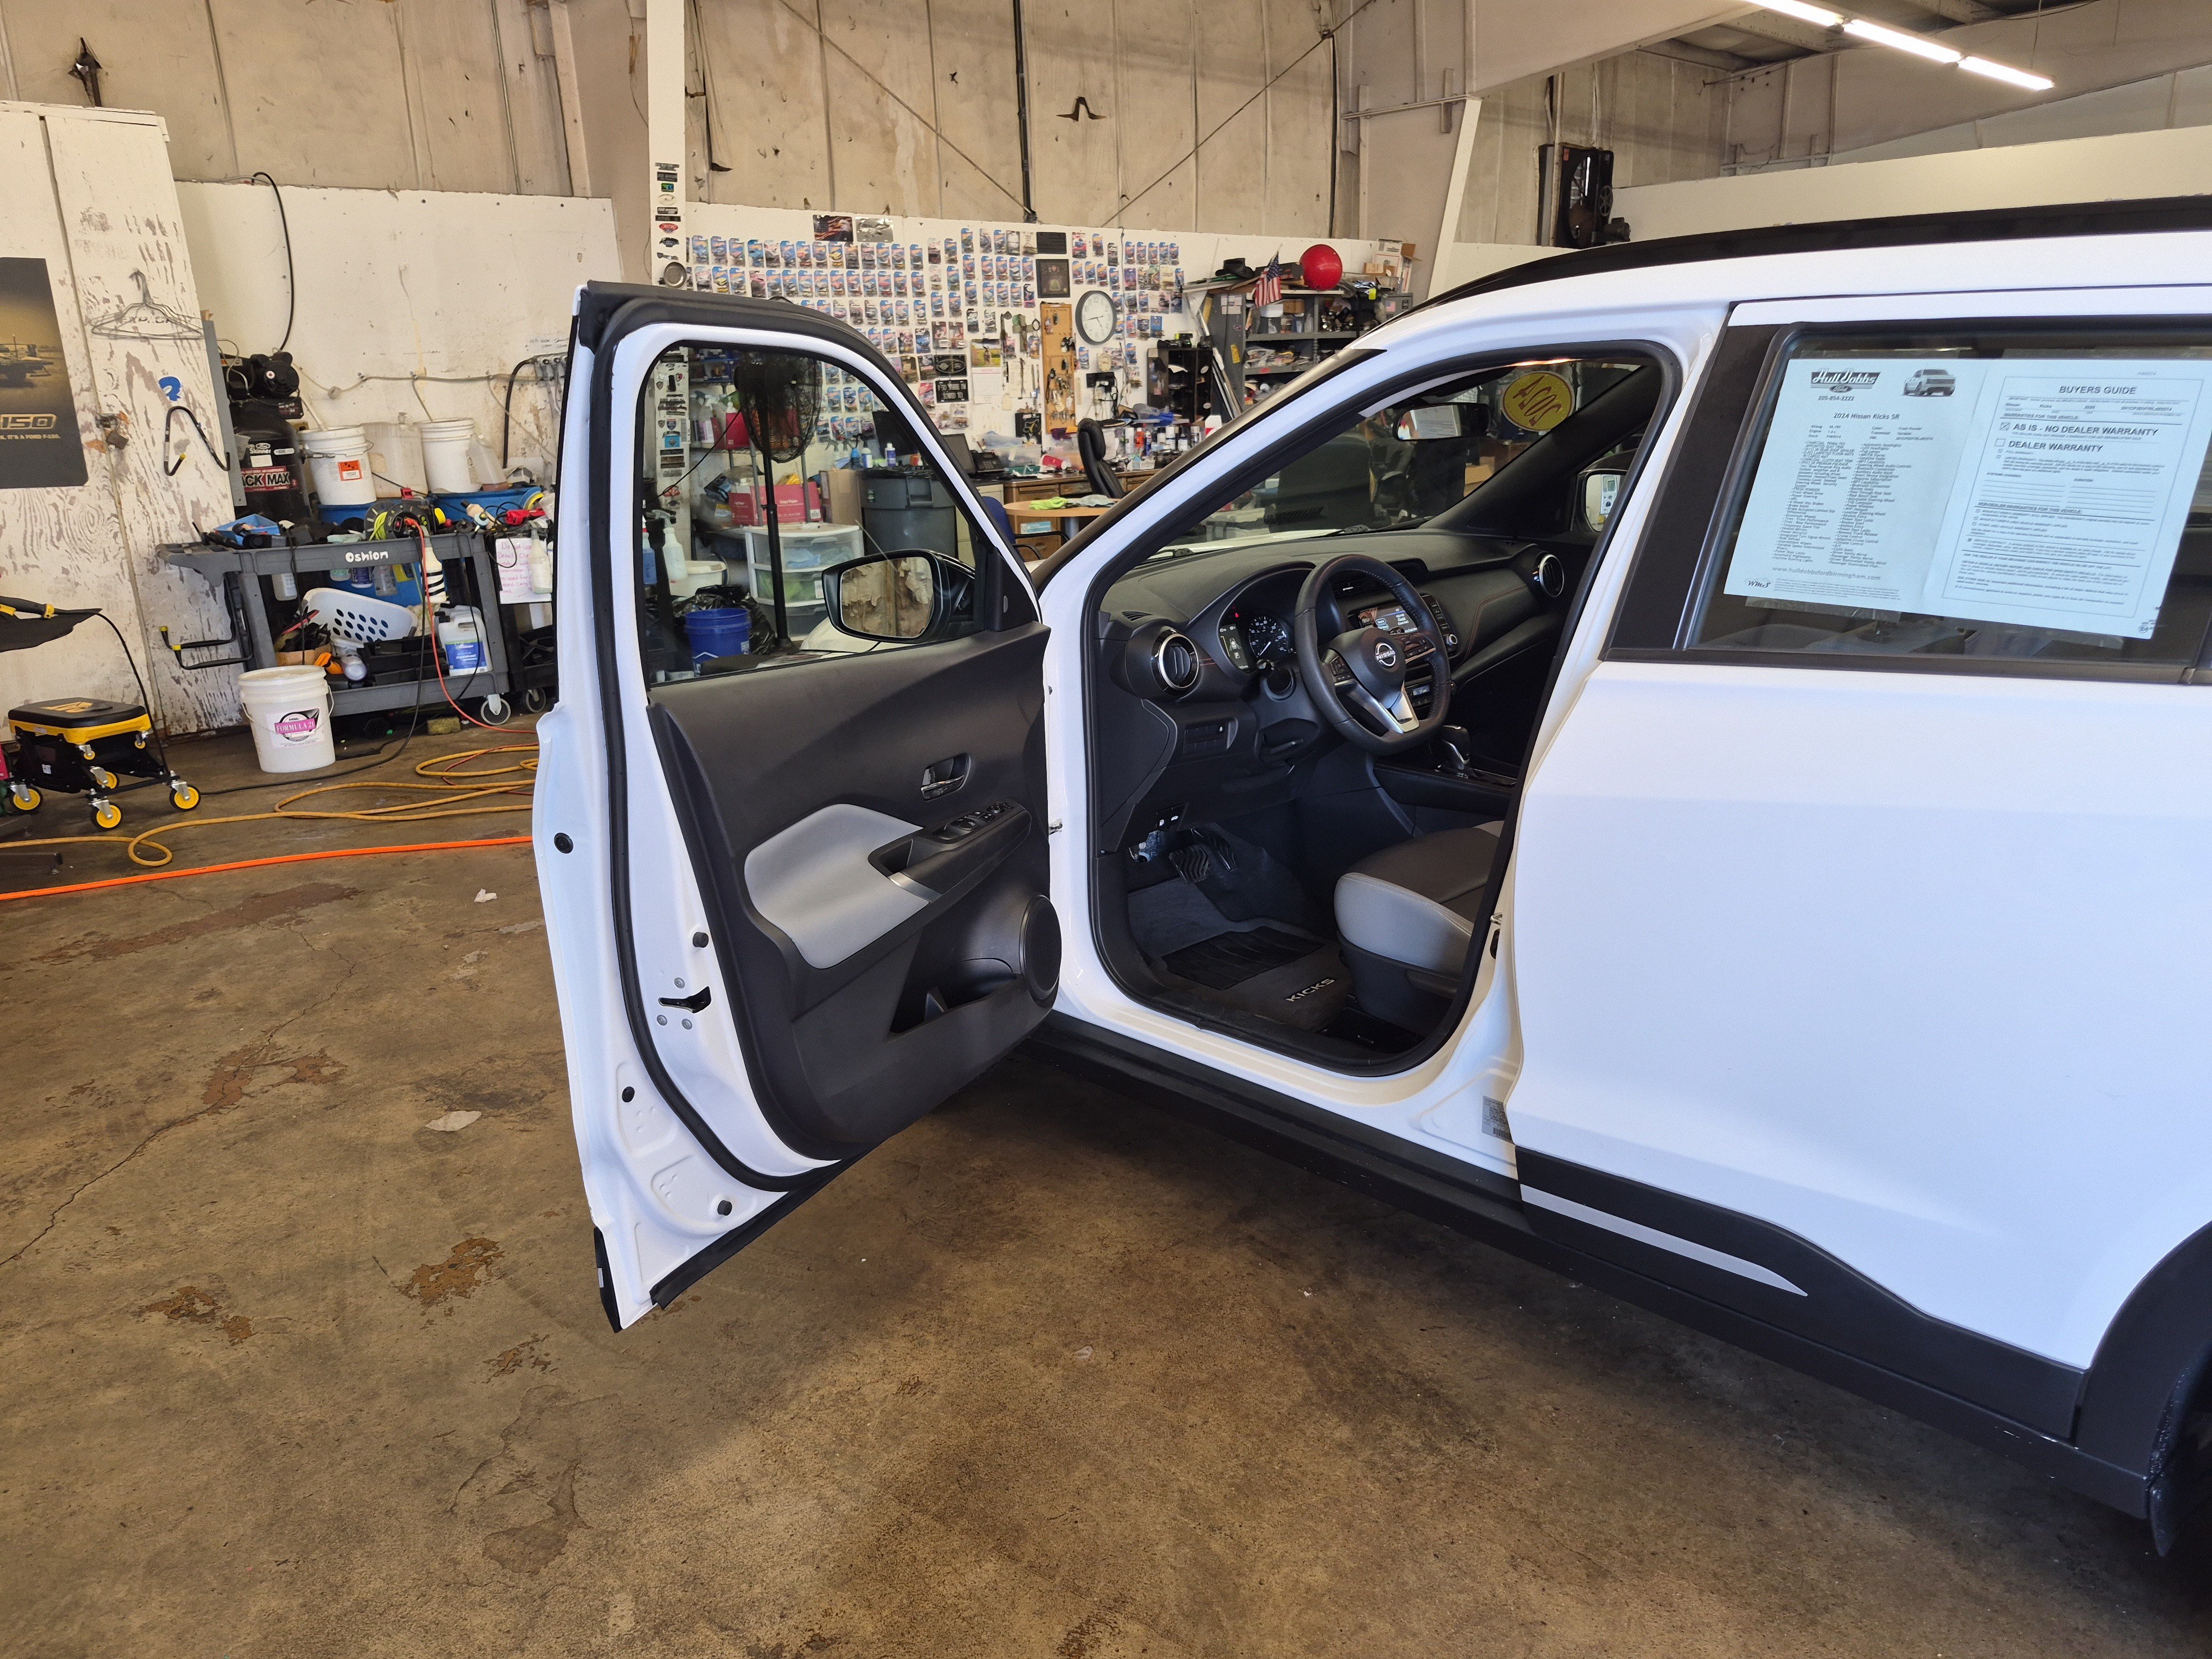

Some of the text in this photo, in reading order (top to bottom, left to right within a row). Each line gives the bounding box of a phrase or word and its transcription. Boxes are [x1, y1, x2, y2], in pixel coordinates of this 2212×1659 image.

[2059, 385, 2137, 395] BUYERS GUIDE
[2012, 423, 2027, 432] AS
[2029, 424, 2038, 432] IS
[2045, 425, 2060, 433] NO
[2061, 426, 2100, 435] DEALER
[2102, 427, 2159, 437] WARRANTY
[2008, 440, 2104, 453] DEALER WARRANTY
[266, 472, 291, 486] MAX
[345, 550, 389, 563] Oshion
